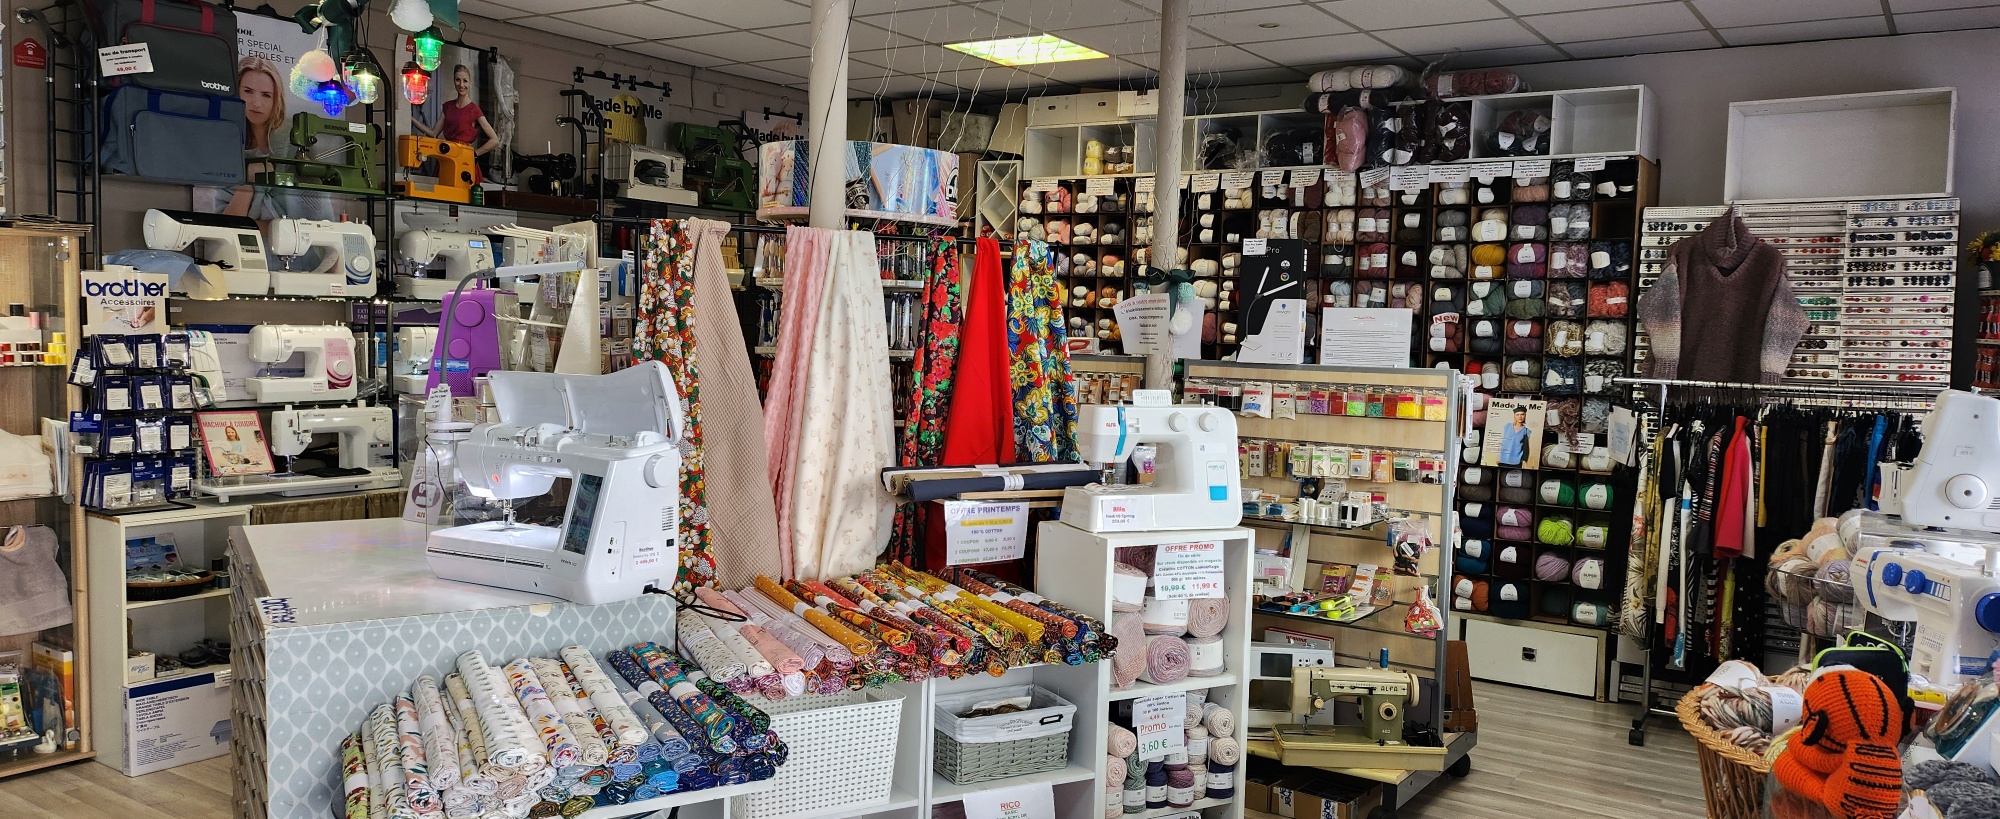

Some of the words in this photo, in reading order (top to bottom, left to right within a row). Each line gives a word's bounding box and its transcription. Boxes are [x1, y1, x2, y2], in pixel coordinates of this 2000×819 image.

[247, 39, 283, 52] SPECIAL
[248, 48, 281, 62] ÉTOLES
[285, 56, 295, 64] ET
[201, 80, 230, 92] brother
[582, 94, 621, 113] Made
[624, 101, 640, 118] by
[643, 104, 663, 119] Me
[582, 112, 612, 129] Men
[324, 124, 348, 132] BERNINA
[1267, 246, 1280, 254] Pro
[86, 279, 166, 296] brother
[100, 298, 155, 306] Accessoires
[1434, 315, 1459, 324] New
[978, 505, 1021, 514] PRINTEMPS
[1140, 722, 1166, 734] Promo
[1142, 740, 1159, 754] 3,60
[1162, 738, 1168, 748] €
[1000, 801, 1021, 810] RICO
